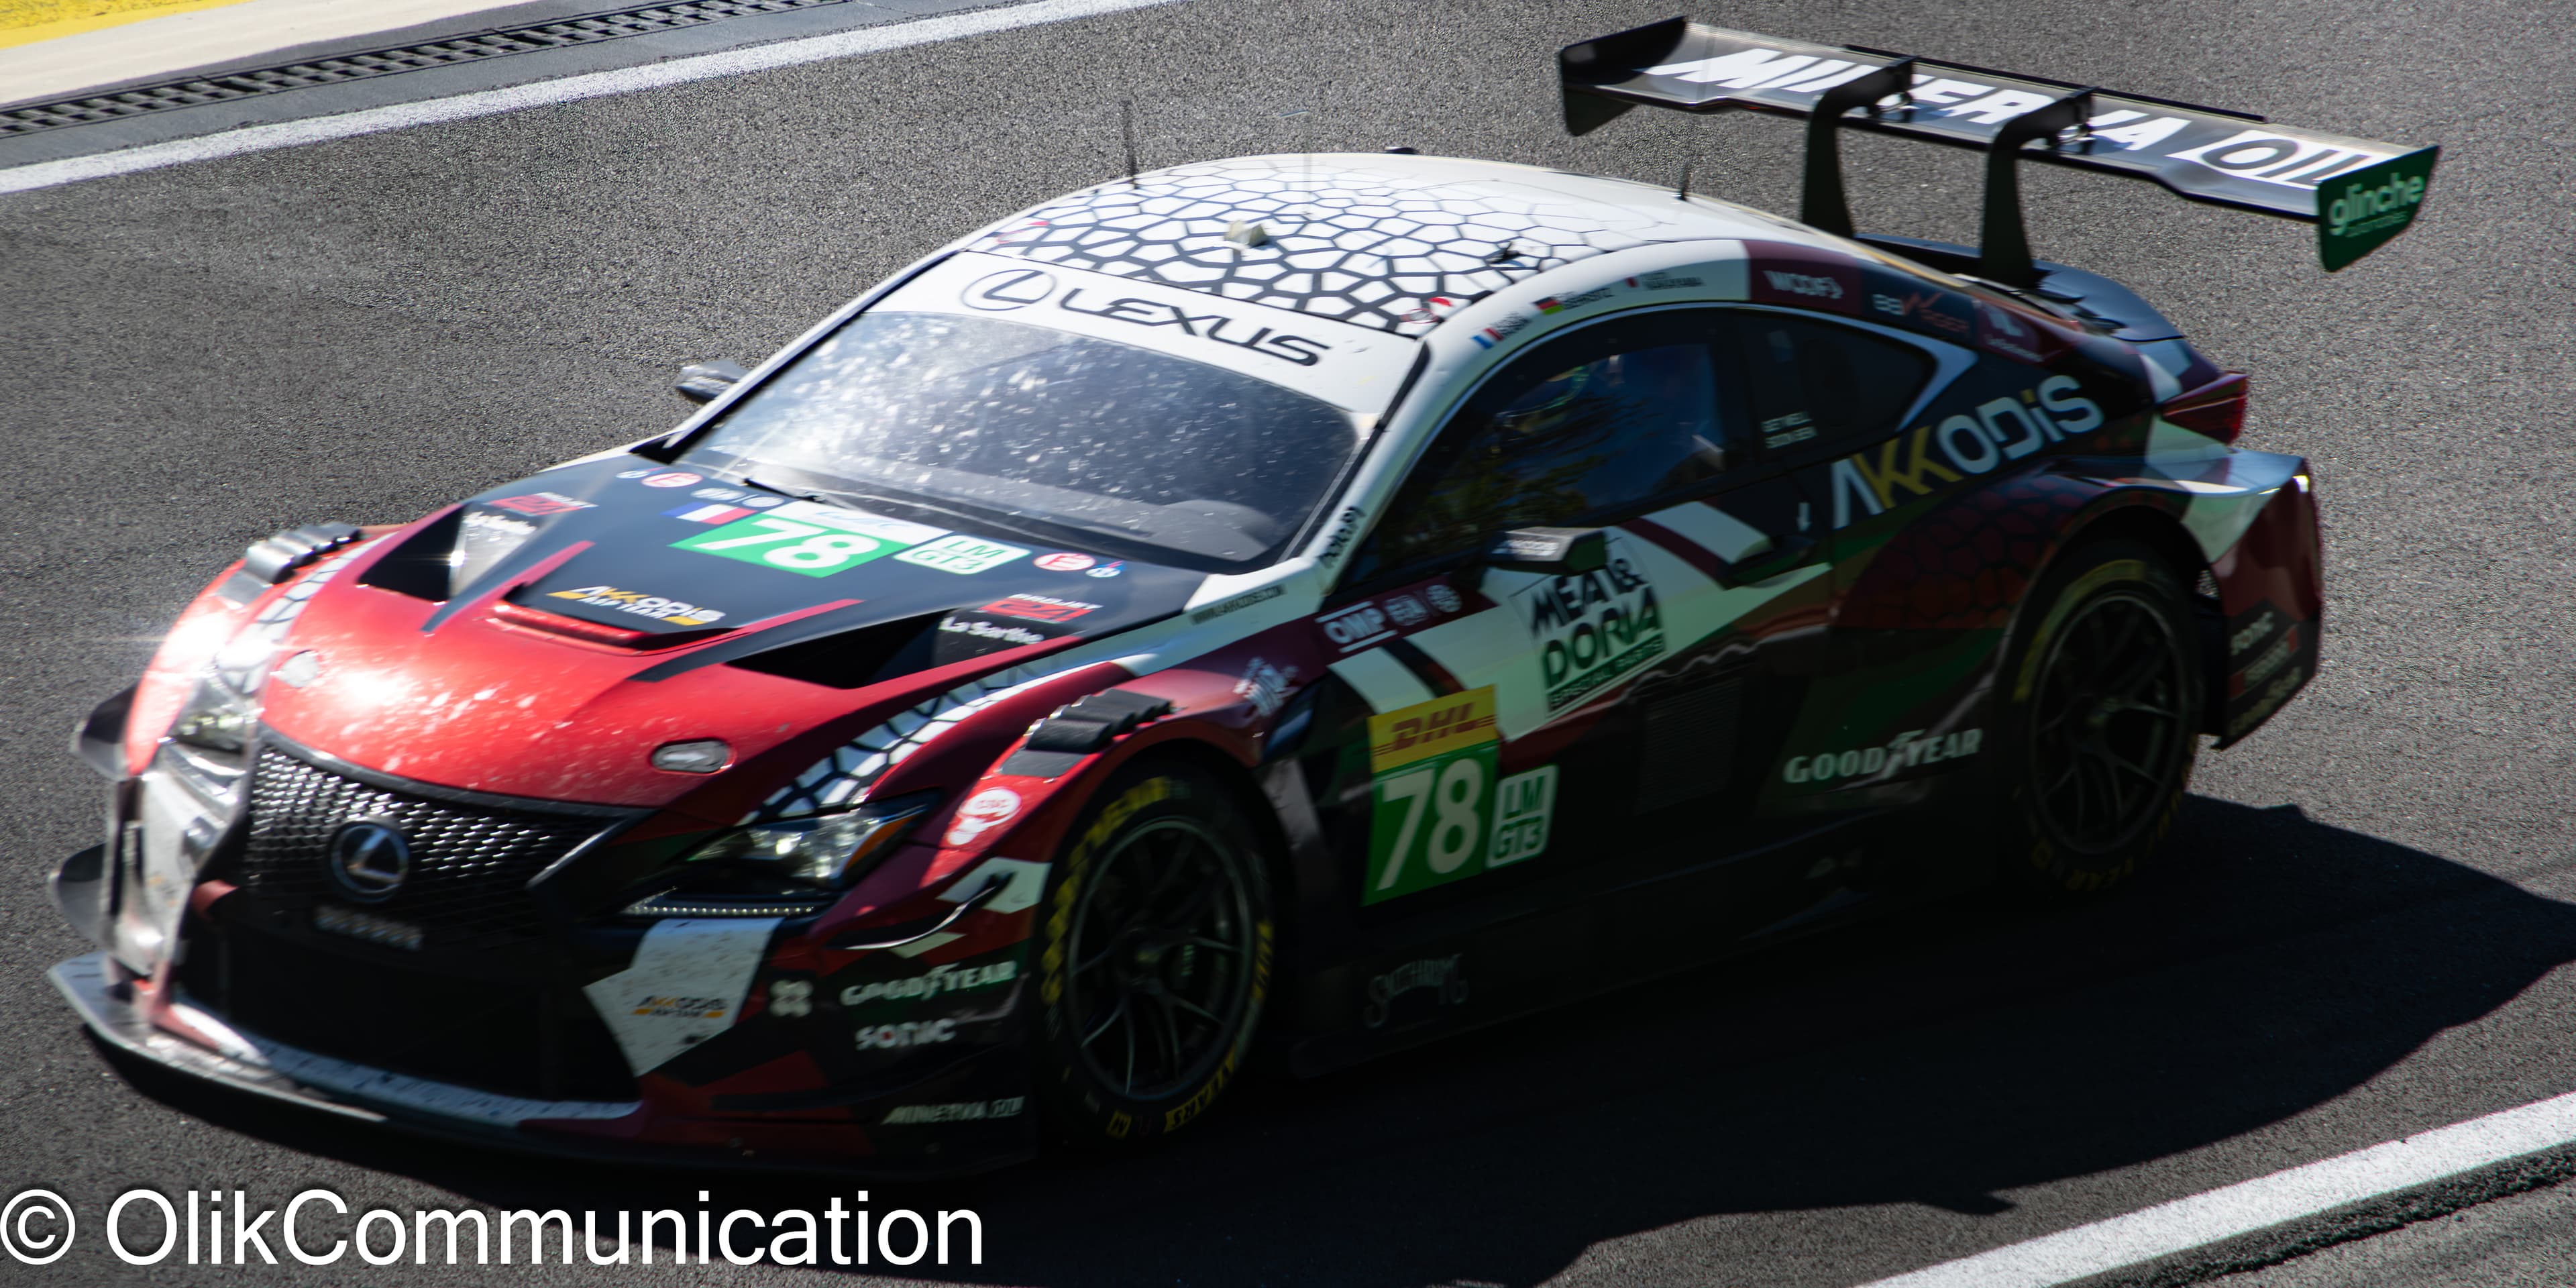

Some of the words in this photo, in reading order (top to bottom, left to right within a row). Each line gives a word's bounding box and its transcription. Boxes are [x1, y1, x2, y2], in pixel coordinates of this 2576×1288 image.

[2328, 172, 2425, 235] glinche
[1059, 288, 1333, 366] LEXUS
[692, 518, 881, 568] 78
[912, 549, 983, 570] GT3
[943, 541, 1005, 558] LM
[1324, 609, 1385, 644] OMP
[1532, 572, 1609, 634] MEA
[1542, 587, 1664, 688] DORIA
[1390, 702, 1477, 751] DHL
[1783, 729, 1983, 783] GOODYEAR
[1504, 775, 1547, 819] LM
[1375, 758, 1483, 891] 78
[1493, 816, 1543, 859] GT3
[856, 1018, 957, 1051] SONIC
